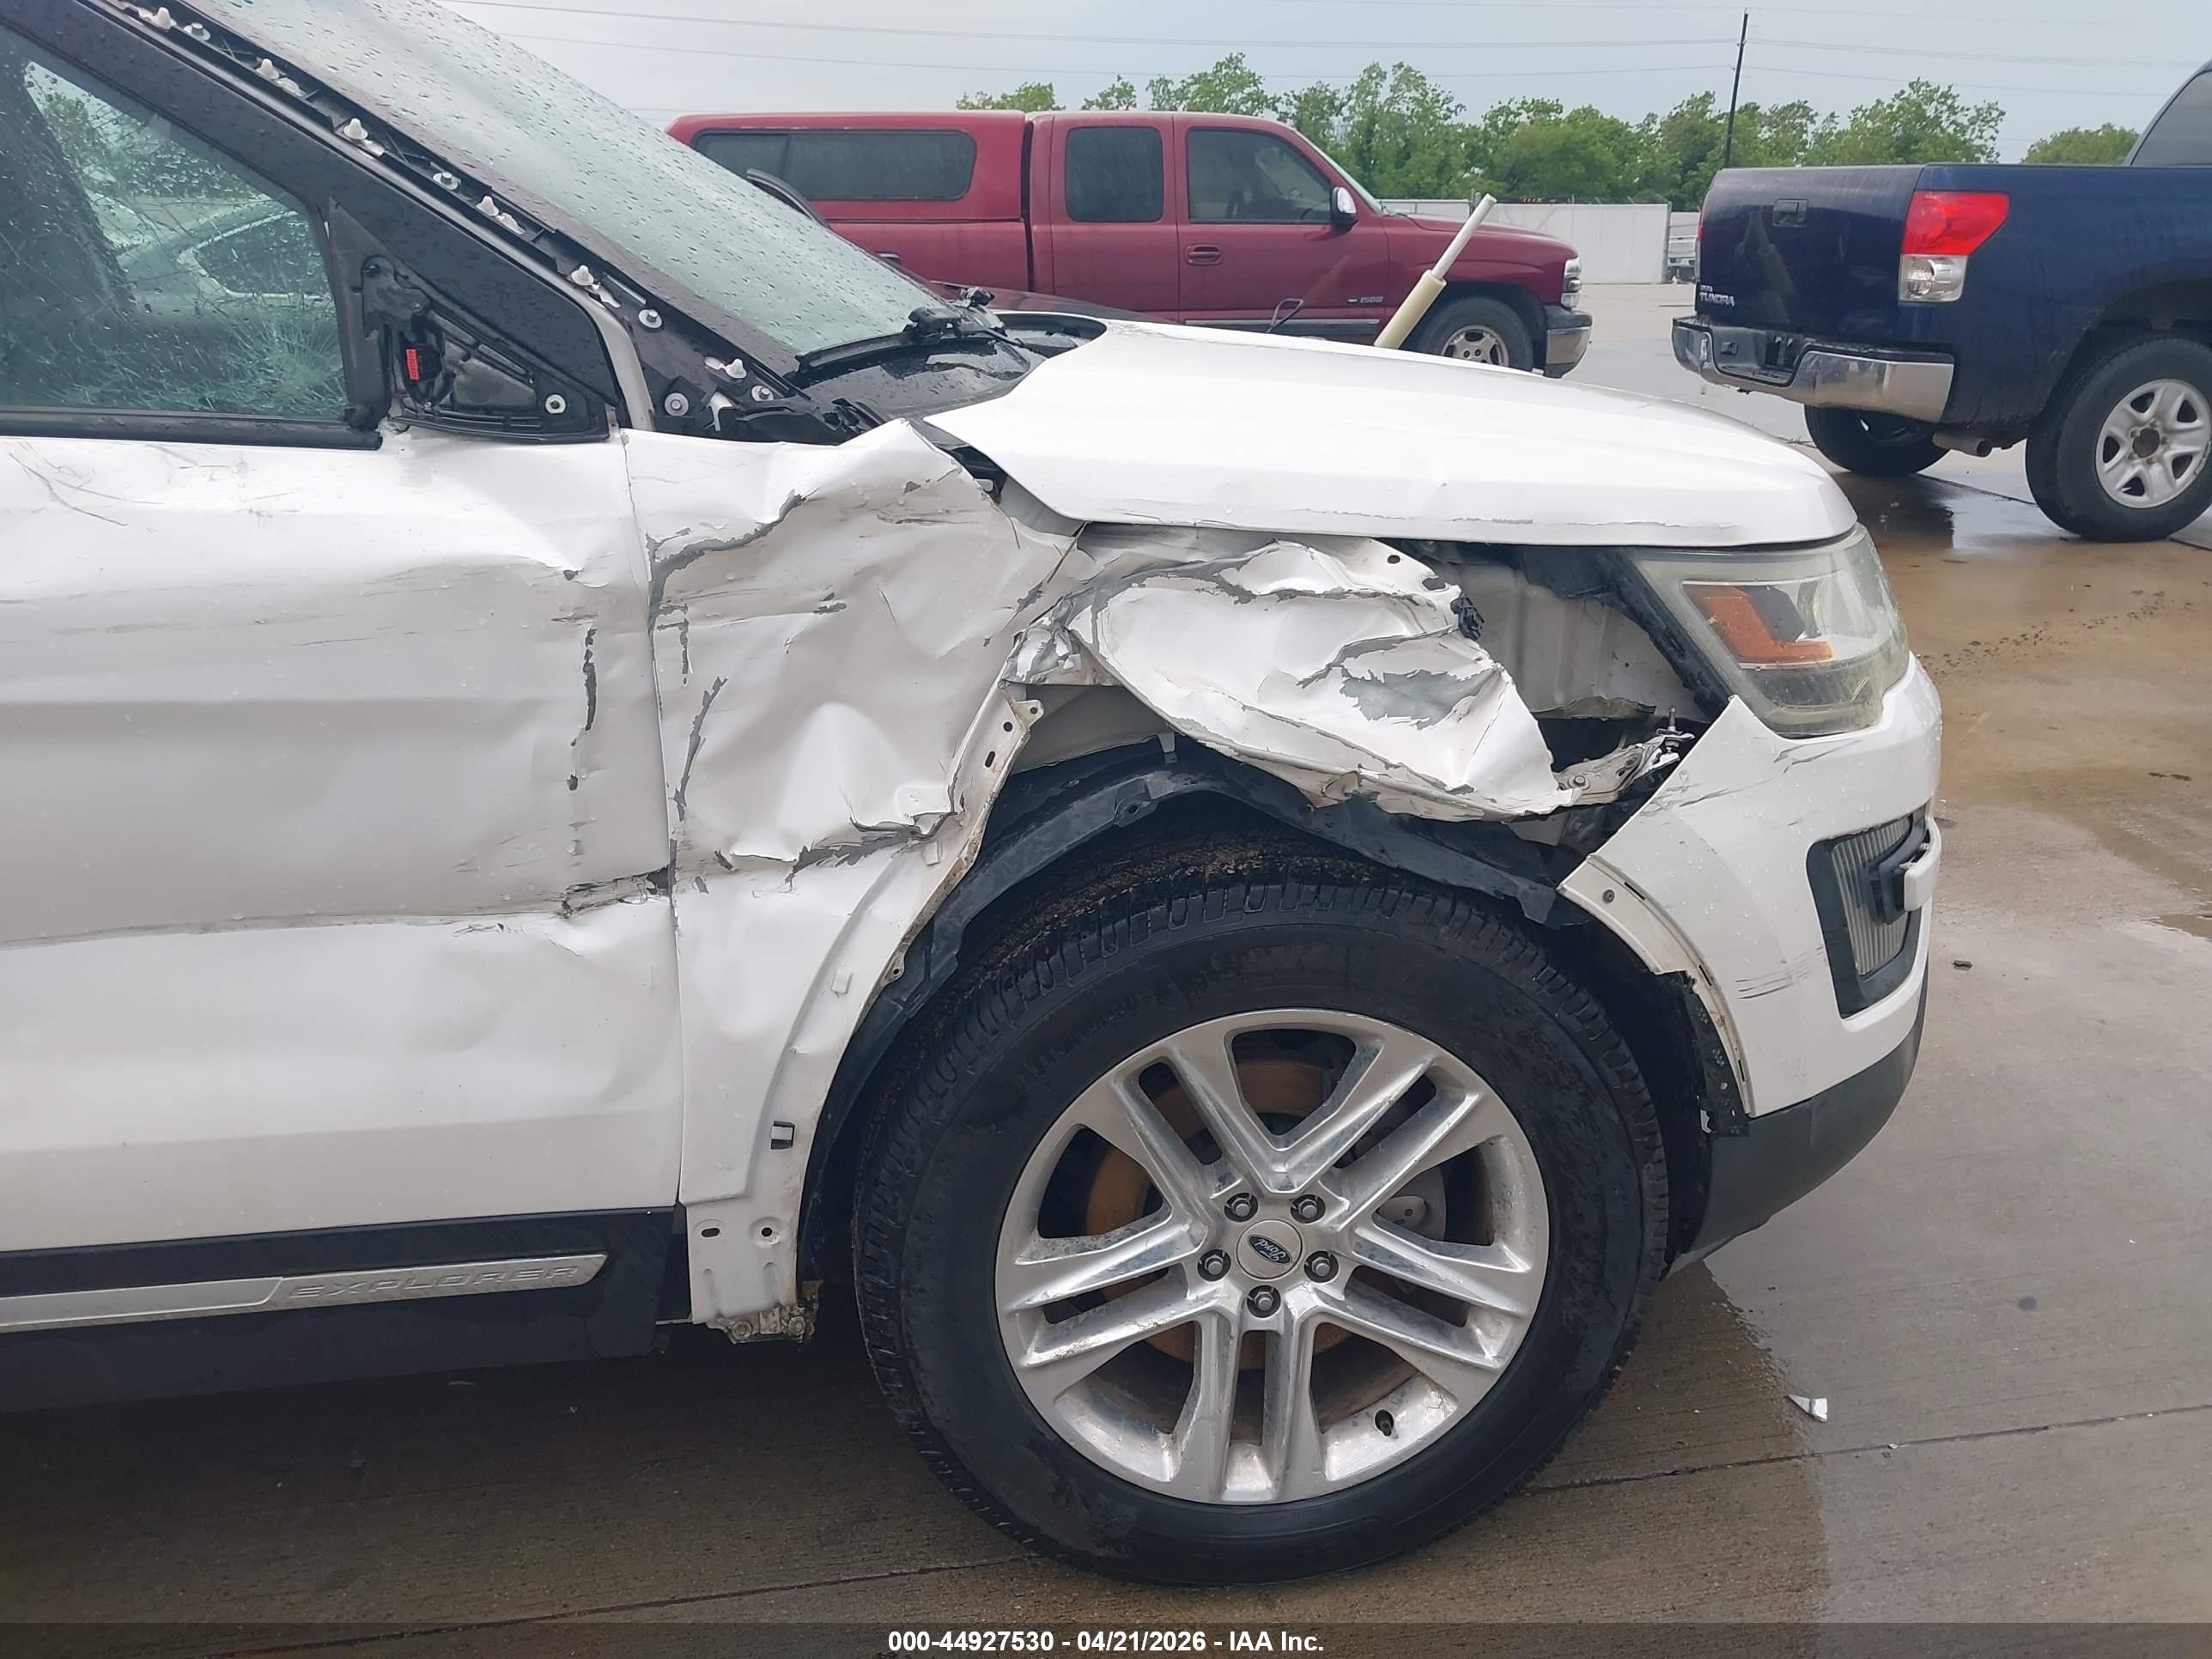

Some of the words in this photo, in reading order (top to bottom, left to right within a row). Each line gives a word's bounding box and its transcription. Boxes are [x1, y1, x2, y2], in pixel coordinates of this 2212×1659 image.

[1699, 292, 1735, 307] TUNDRA
[1255, 1238, 1286, 1261] Ford
[288, 1265, 579, 1299] EXPLORER
